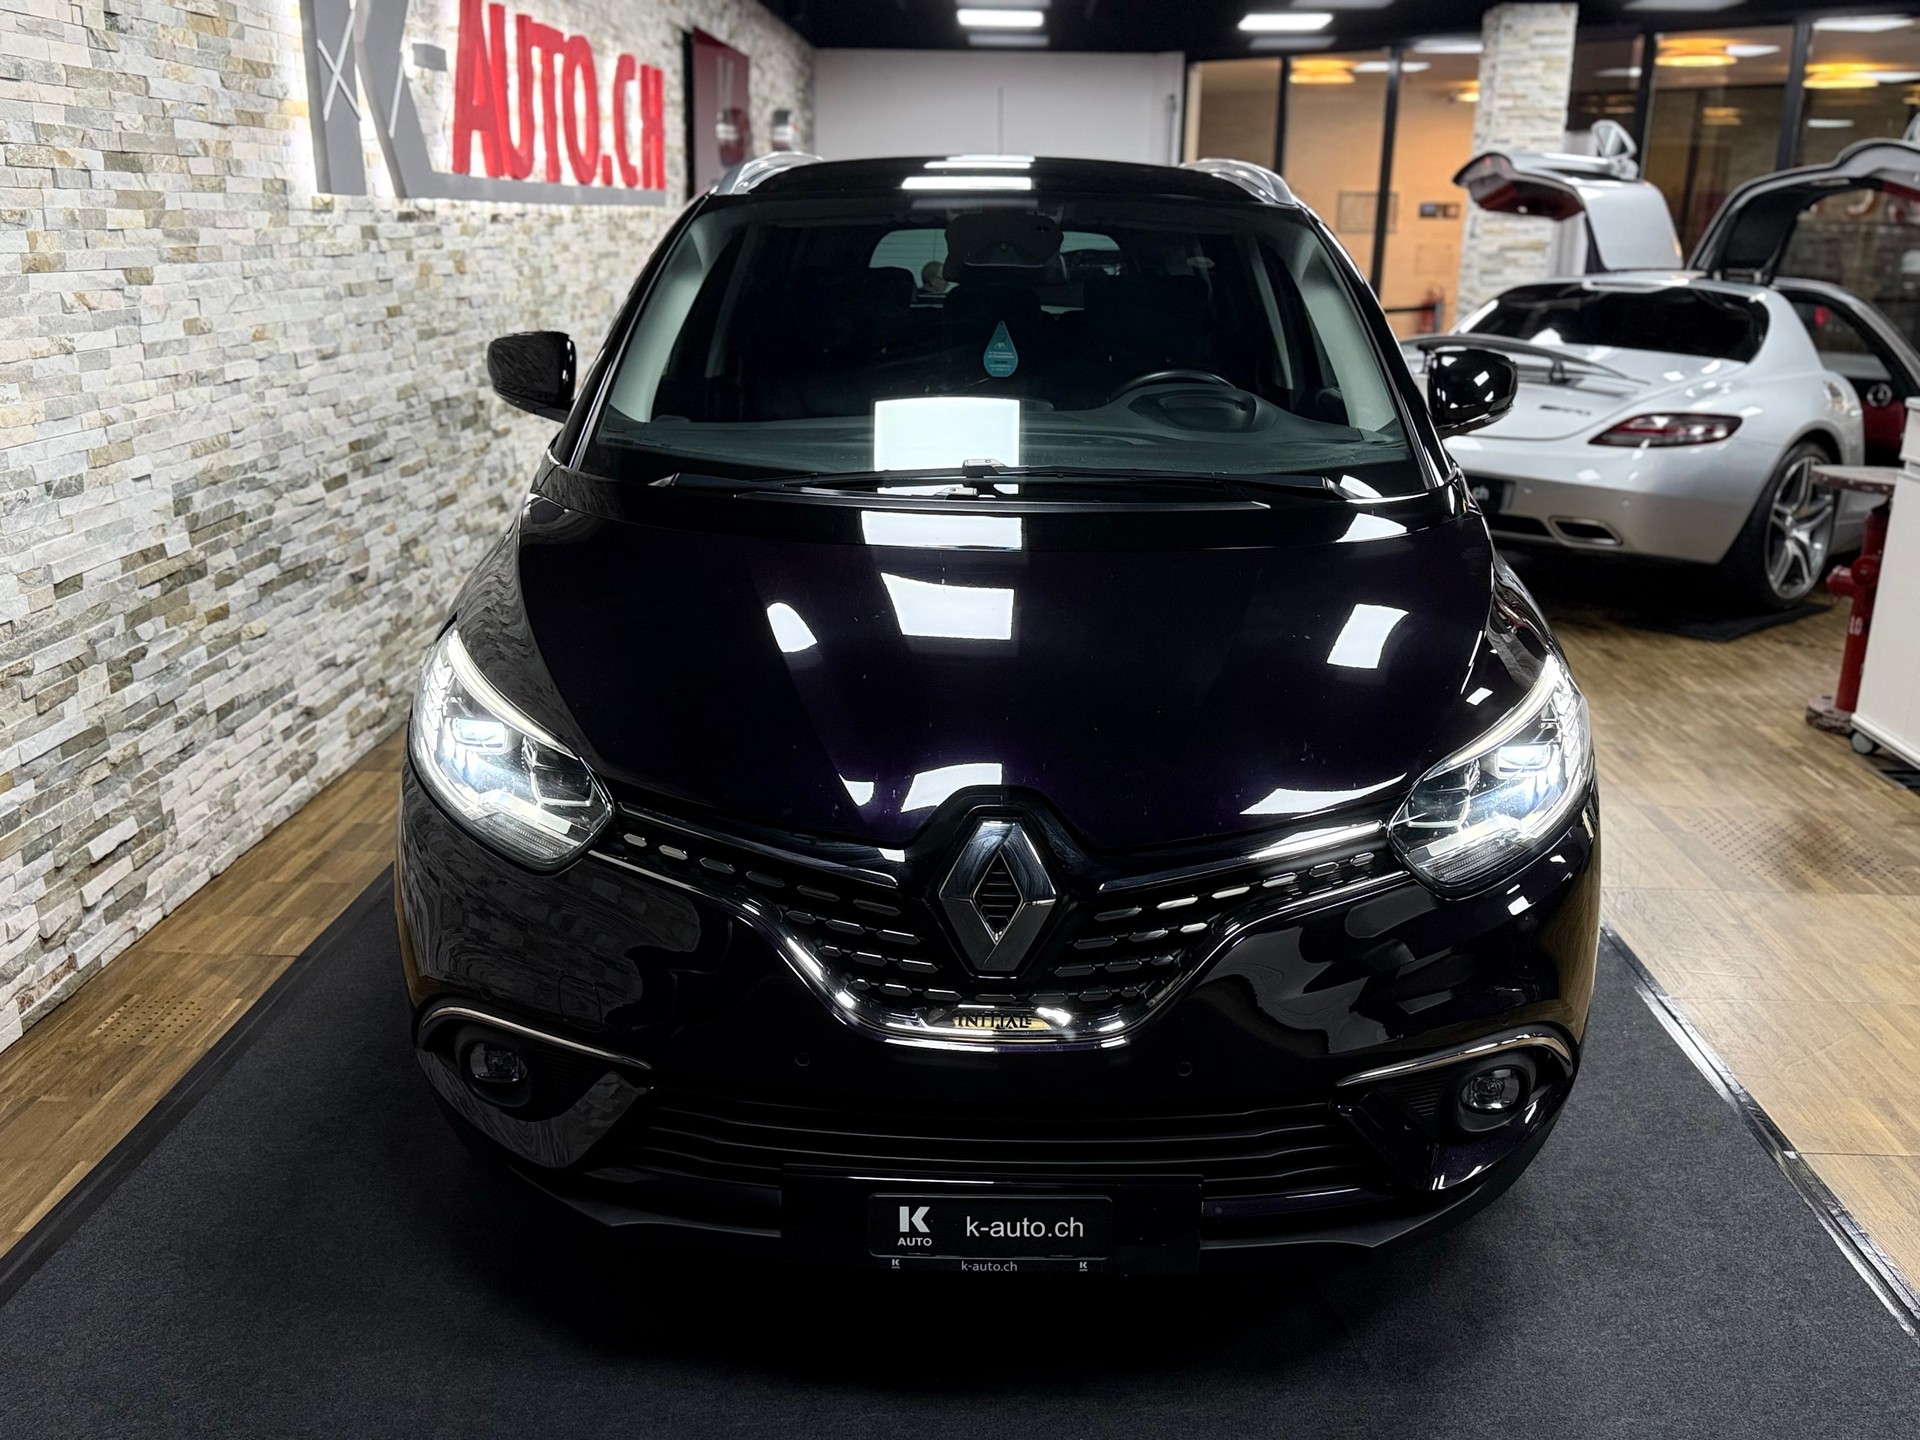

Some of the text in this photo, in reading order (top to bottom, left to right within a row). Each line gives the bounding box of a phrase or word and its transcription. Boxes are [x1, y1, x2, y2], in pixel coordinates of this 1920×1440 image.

[900, 1206, 931, 1233] K
[966, 1215, 1085, 1238] k-auto.ch
[897, 1237, 933, 1247] AUTO
[961, 1260, 1018, 1272] k-auto.ch
